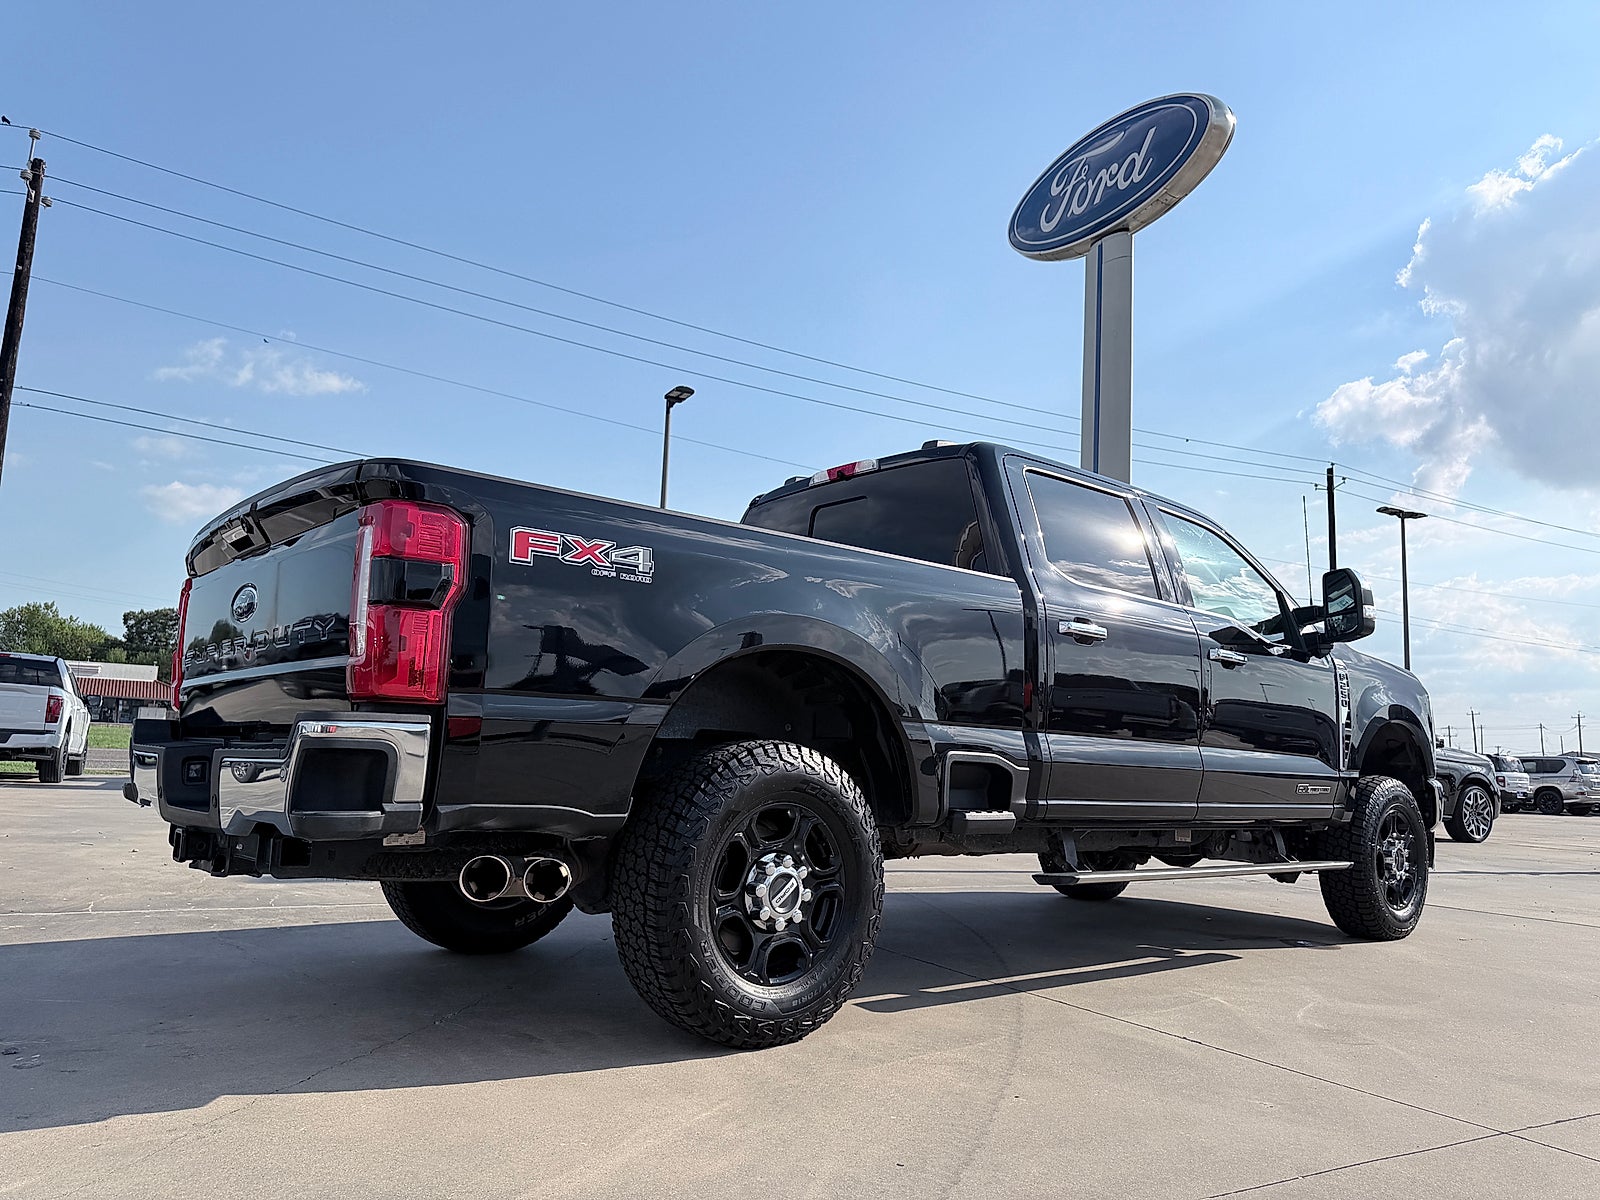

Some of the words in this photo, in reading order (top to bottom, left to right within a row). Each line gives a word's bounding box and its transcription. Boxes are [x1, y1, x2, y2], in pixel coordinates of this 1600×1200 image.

[1040, 126, 1157, 232] Ford
[509, 526, 655, 577] FX4
[254, 614, 336, 652] DUTY
[699, 940, 767, 1013] COOPER
